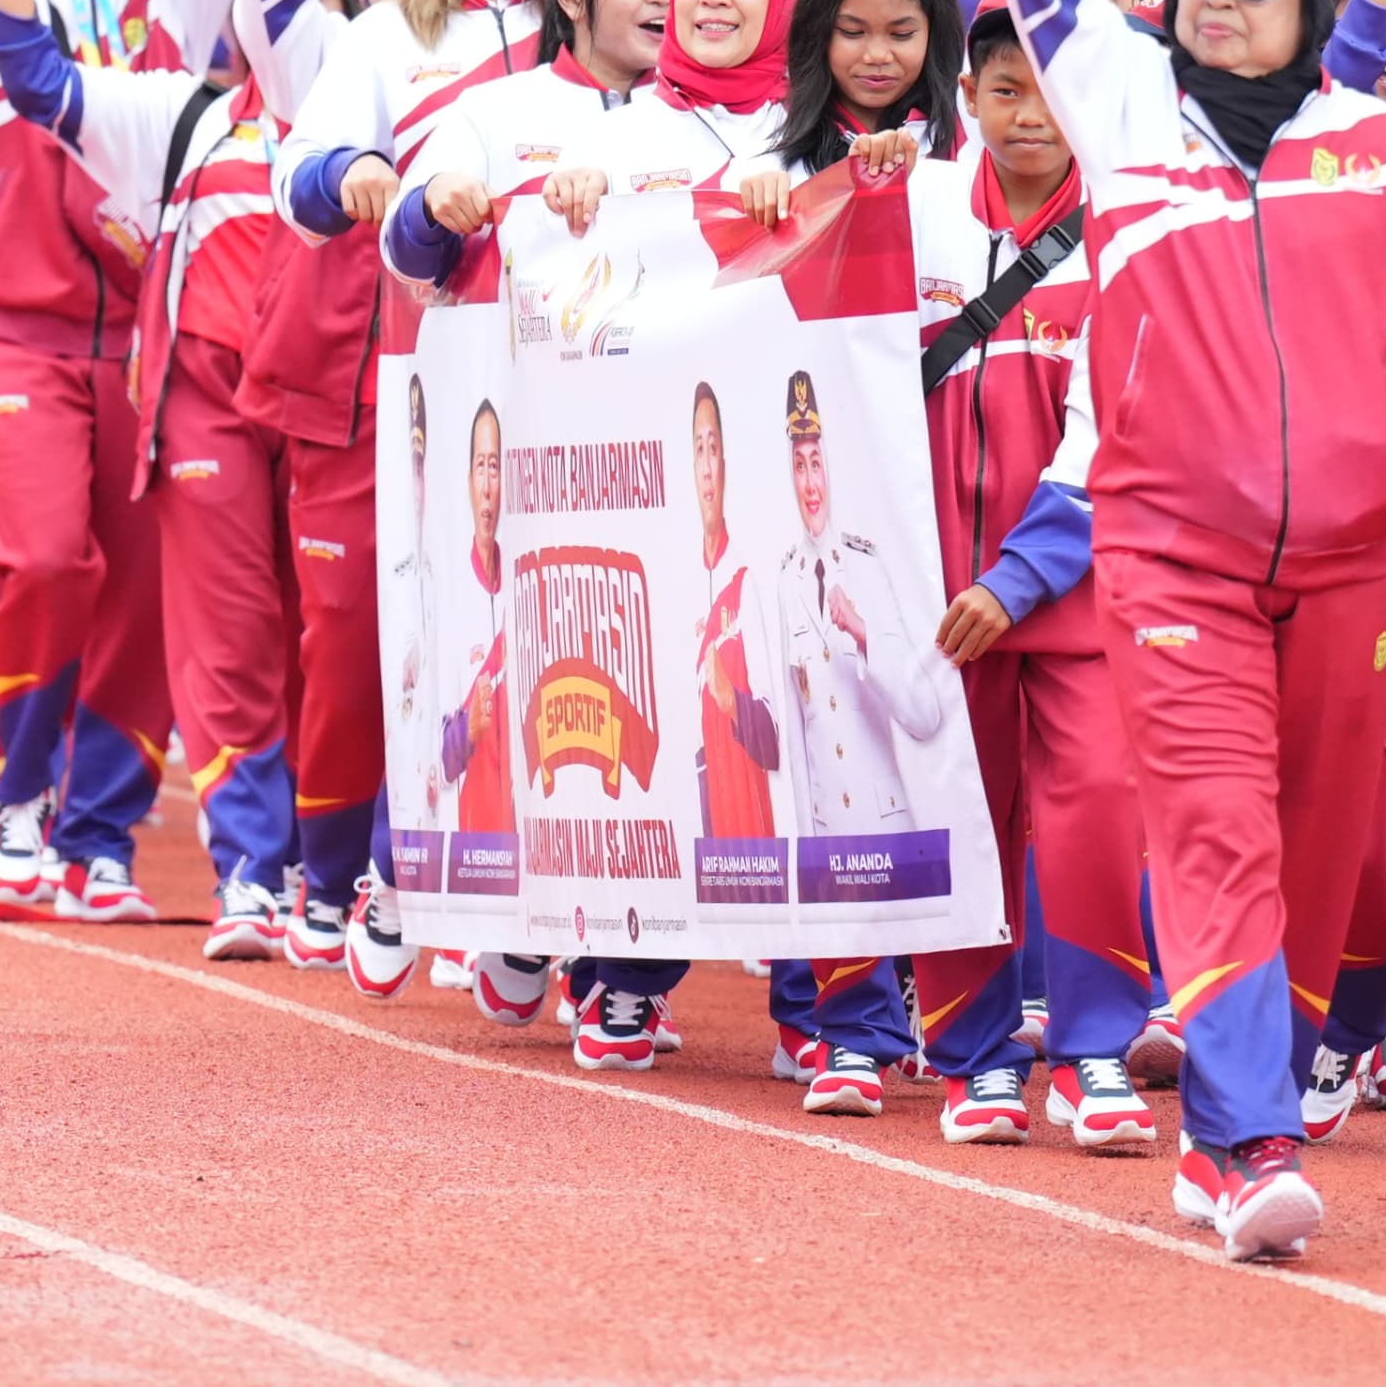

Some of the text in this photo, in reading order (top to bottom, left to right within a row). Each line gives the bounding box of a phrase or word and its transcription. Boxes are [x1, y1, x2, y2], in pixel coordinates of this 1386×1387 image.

[540, 445, 569, 513] KOTA
[570, 440, 666, 512] BANJARMASIN
[546, 693, 606, 739] SPORTIF
[574, 819, 605, 879] MAJU
[605, 819, 682, 879] SEJAHTERA
[701, 855, 779, 873] ARIF RAHMAN HAKIM
[829, 852, 894, 871] HJ. ANANDA
[871, 873, 891, 884] KOTA
